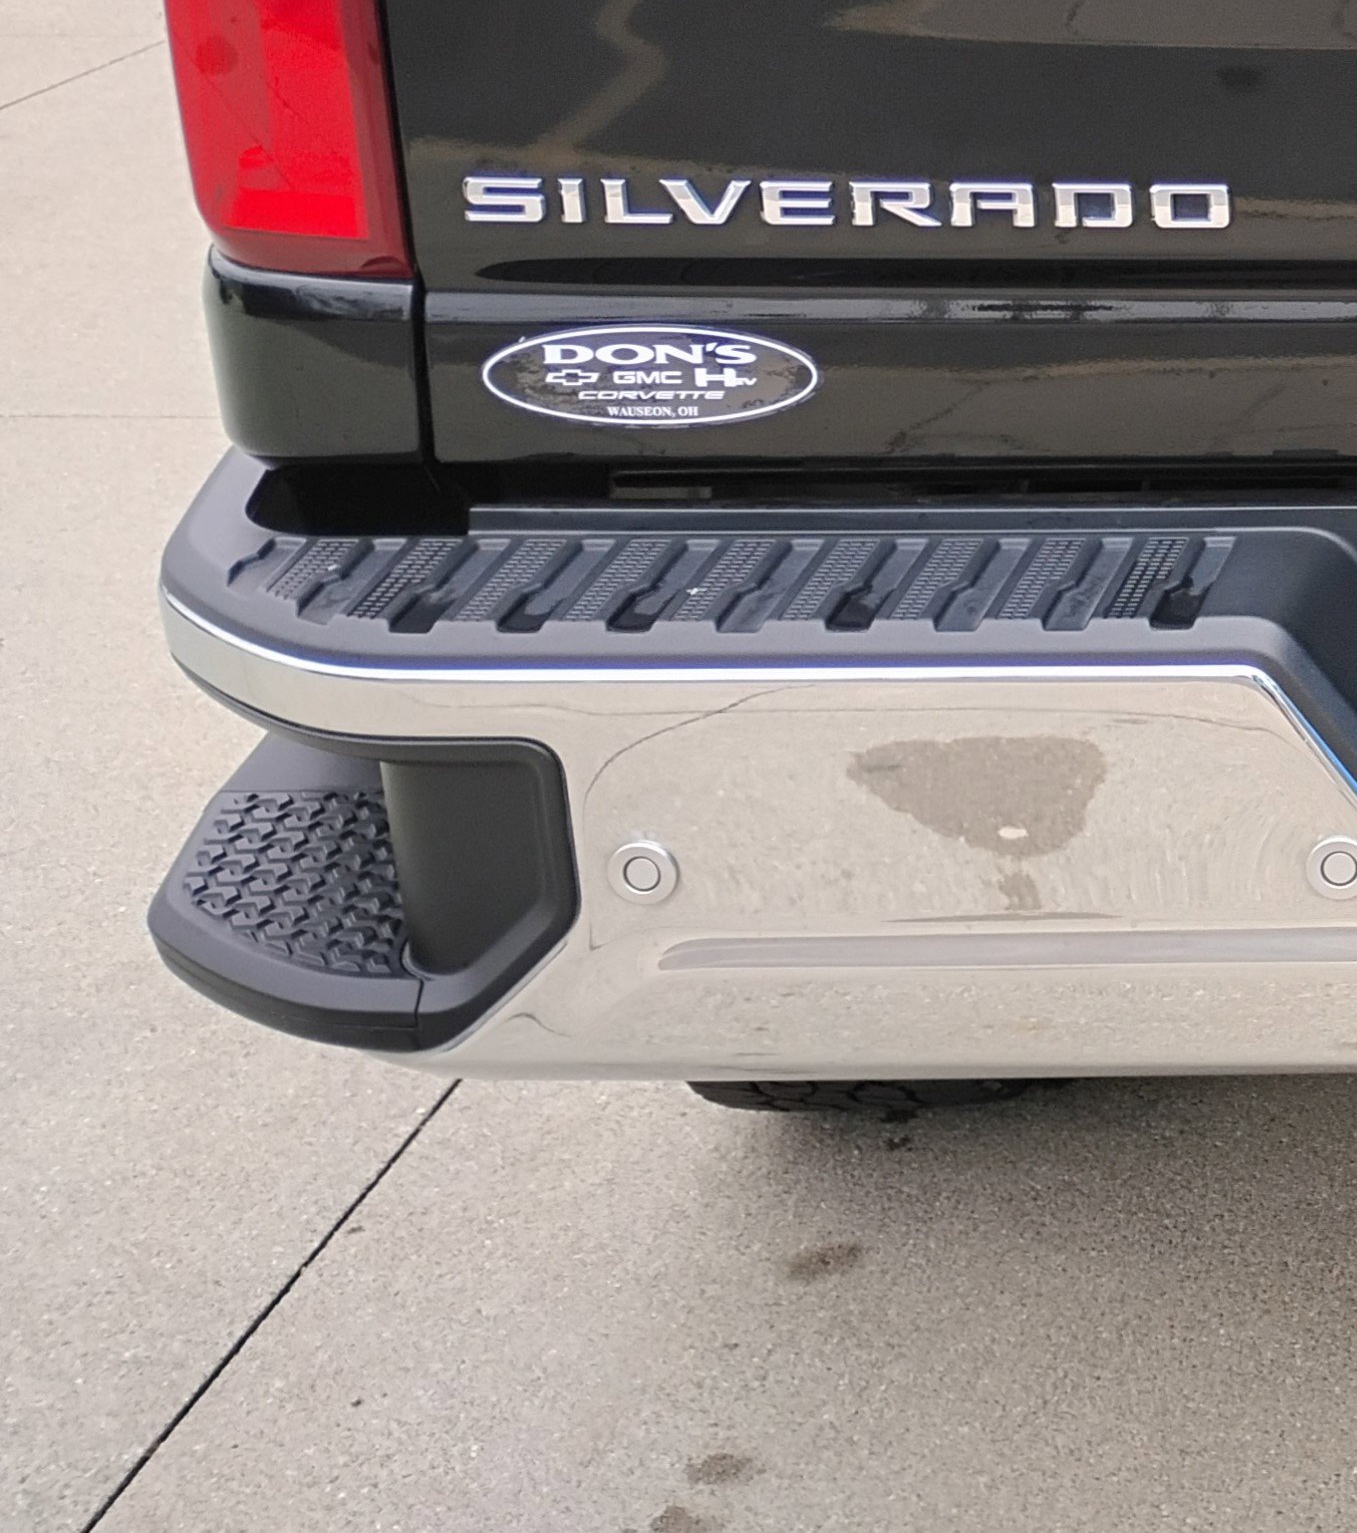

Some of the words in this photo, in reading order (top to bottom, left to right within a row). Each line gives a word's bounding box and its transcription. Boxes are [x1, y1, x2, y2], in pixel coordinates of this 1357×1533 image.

[463, 176, 1230, 229] SILVERADO
[542, 341, 757, 365] DON'S
[613, 370, 682, 385] GMC
[578, 390, 725, 400] CORVETTE
[607, 405, 676, 418] WAUSEON,
[677, 405, 699, 417] OH
